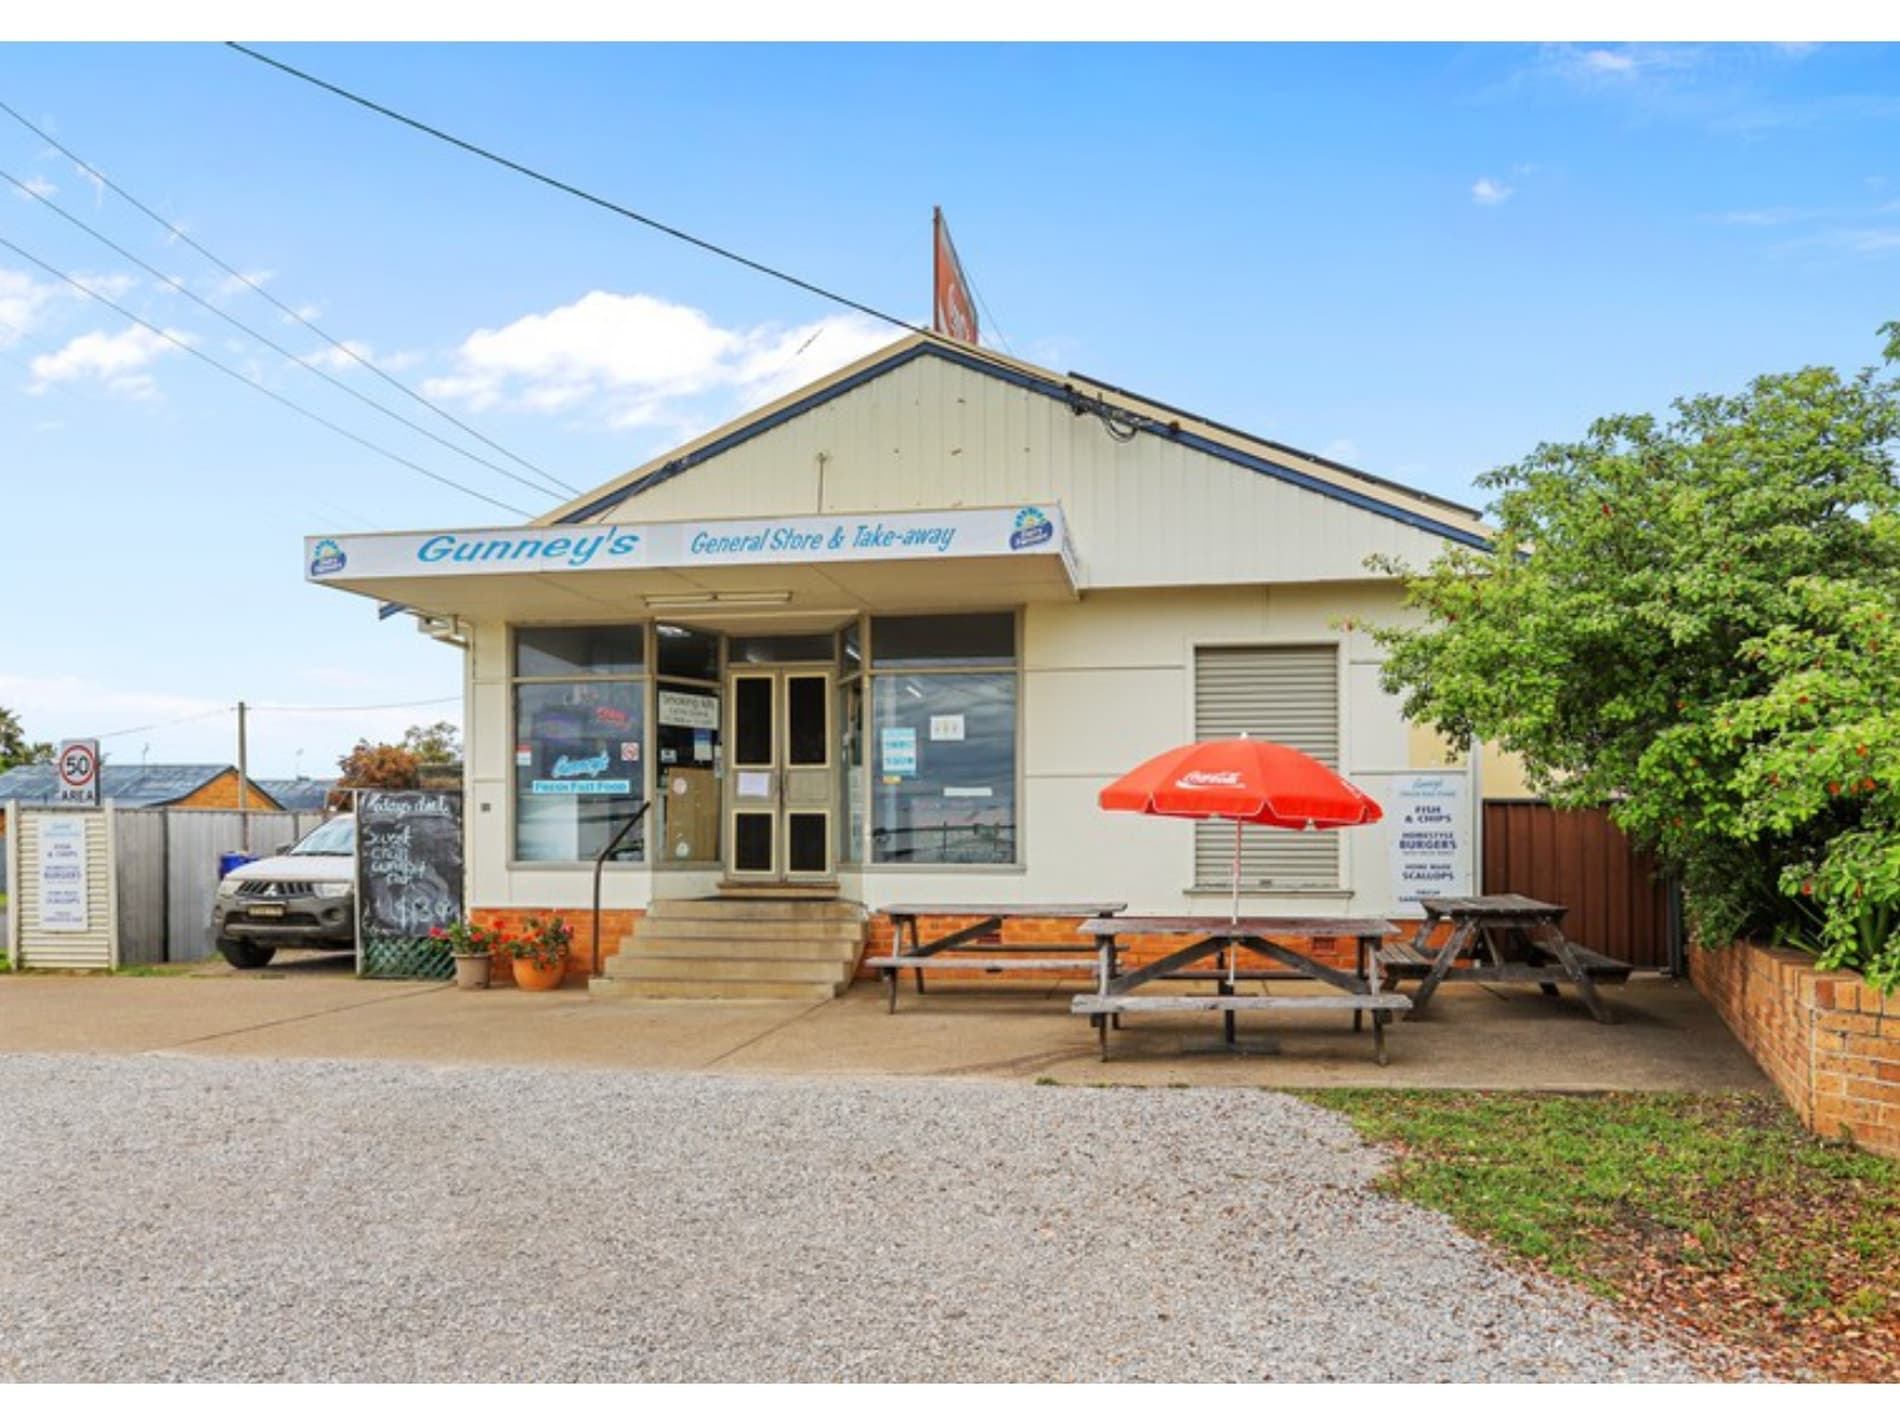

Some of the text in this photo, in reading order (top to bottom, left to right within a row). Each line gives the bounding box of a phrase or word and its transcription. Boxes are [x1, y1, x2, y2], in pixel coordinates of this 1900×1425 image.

[691, 522, 956, 555] General Store & Take-away
[416, 526, 640, 567] Gunney's
[66, 755, 89, 776] 50
[62, 789, 94, 802] AREA
[1415, 805, 1441, 814] FISH
[1417, 814, 1453, 824] CHIPS
[1399, 840, 1457, 849] BURGERS
